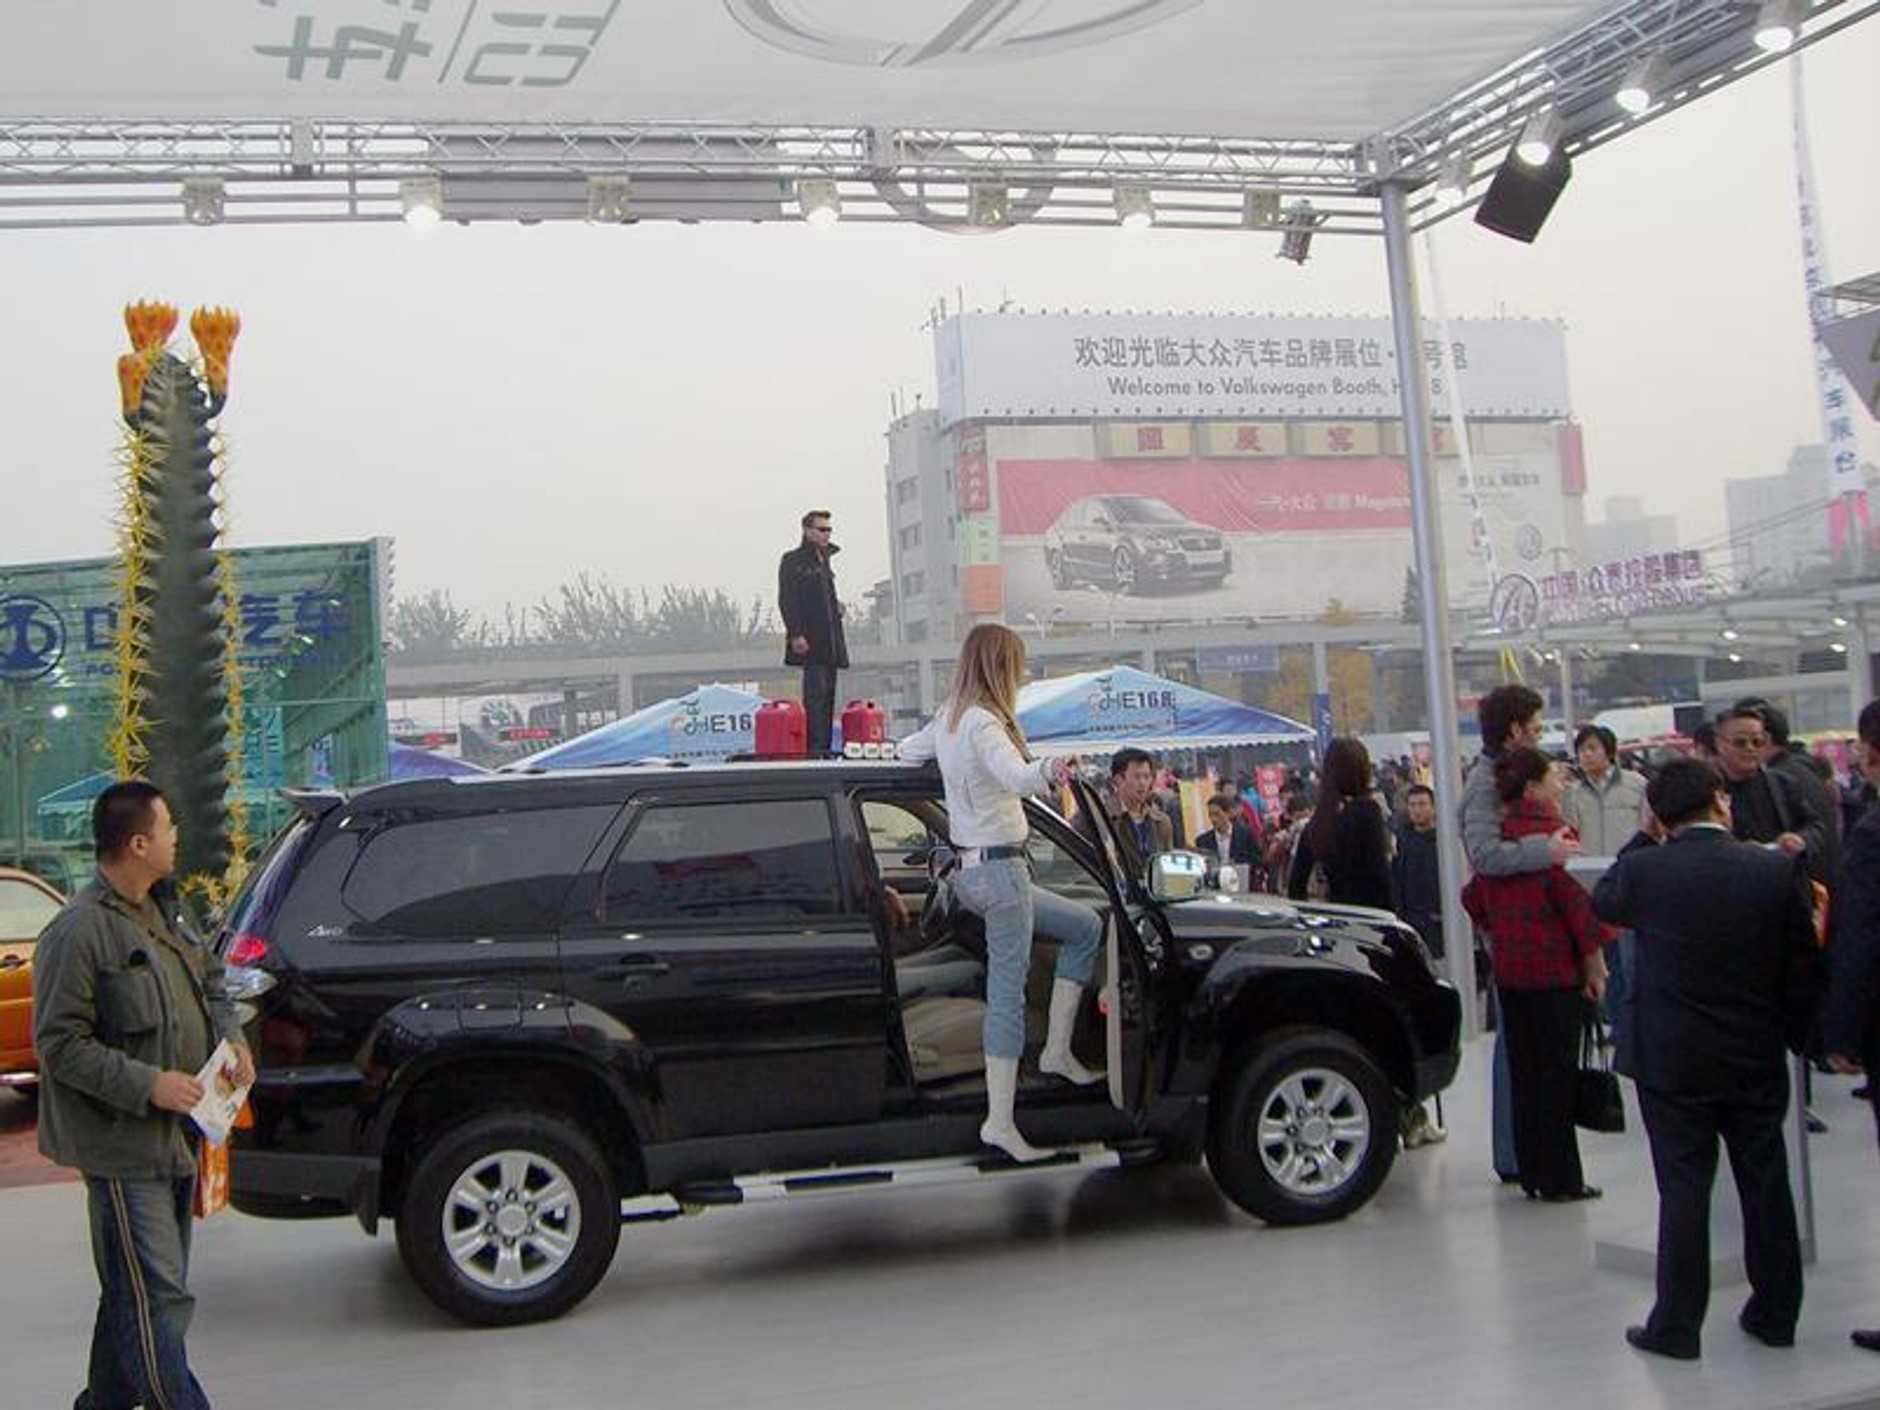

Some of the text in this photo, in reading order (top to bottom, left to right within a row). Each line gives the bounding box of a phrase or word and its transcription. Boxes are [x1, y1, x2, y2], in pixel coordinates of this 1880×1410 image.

[1107, 376, 1191, 396] Welcome
[1198, 377, 1216, 396] to
[1220, 376, 1327, 398] Volkswagen
